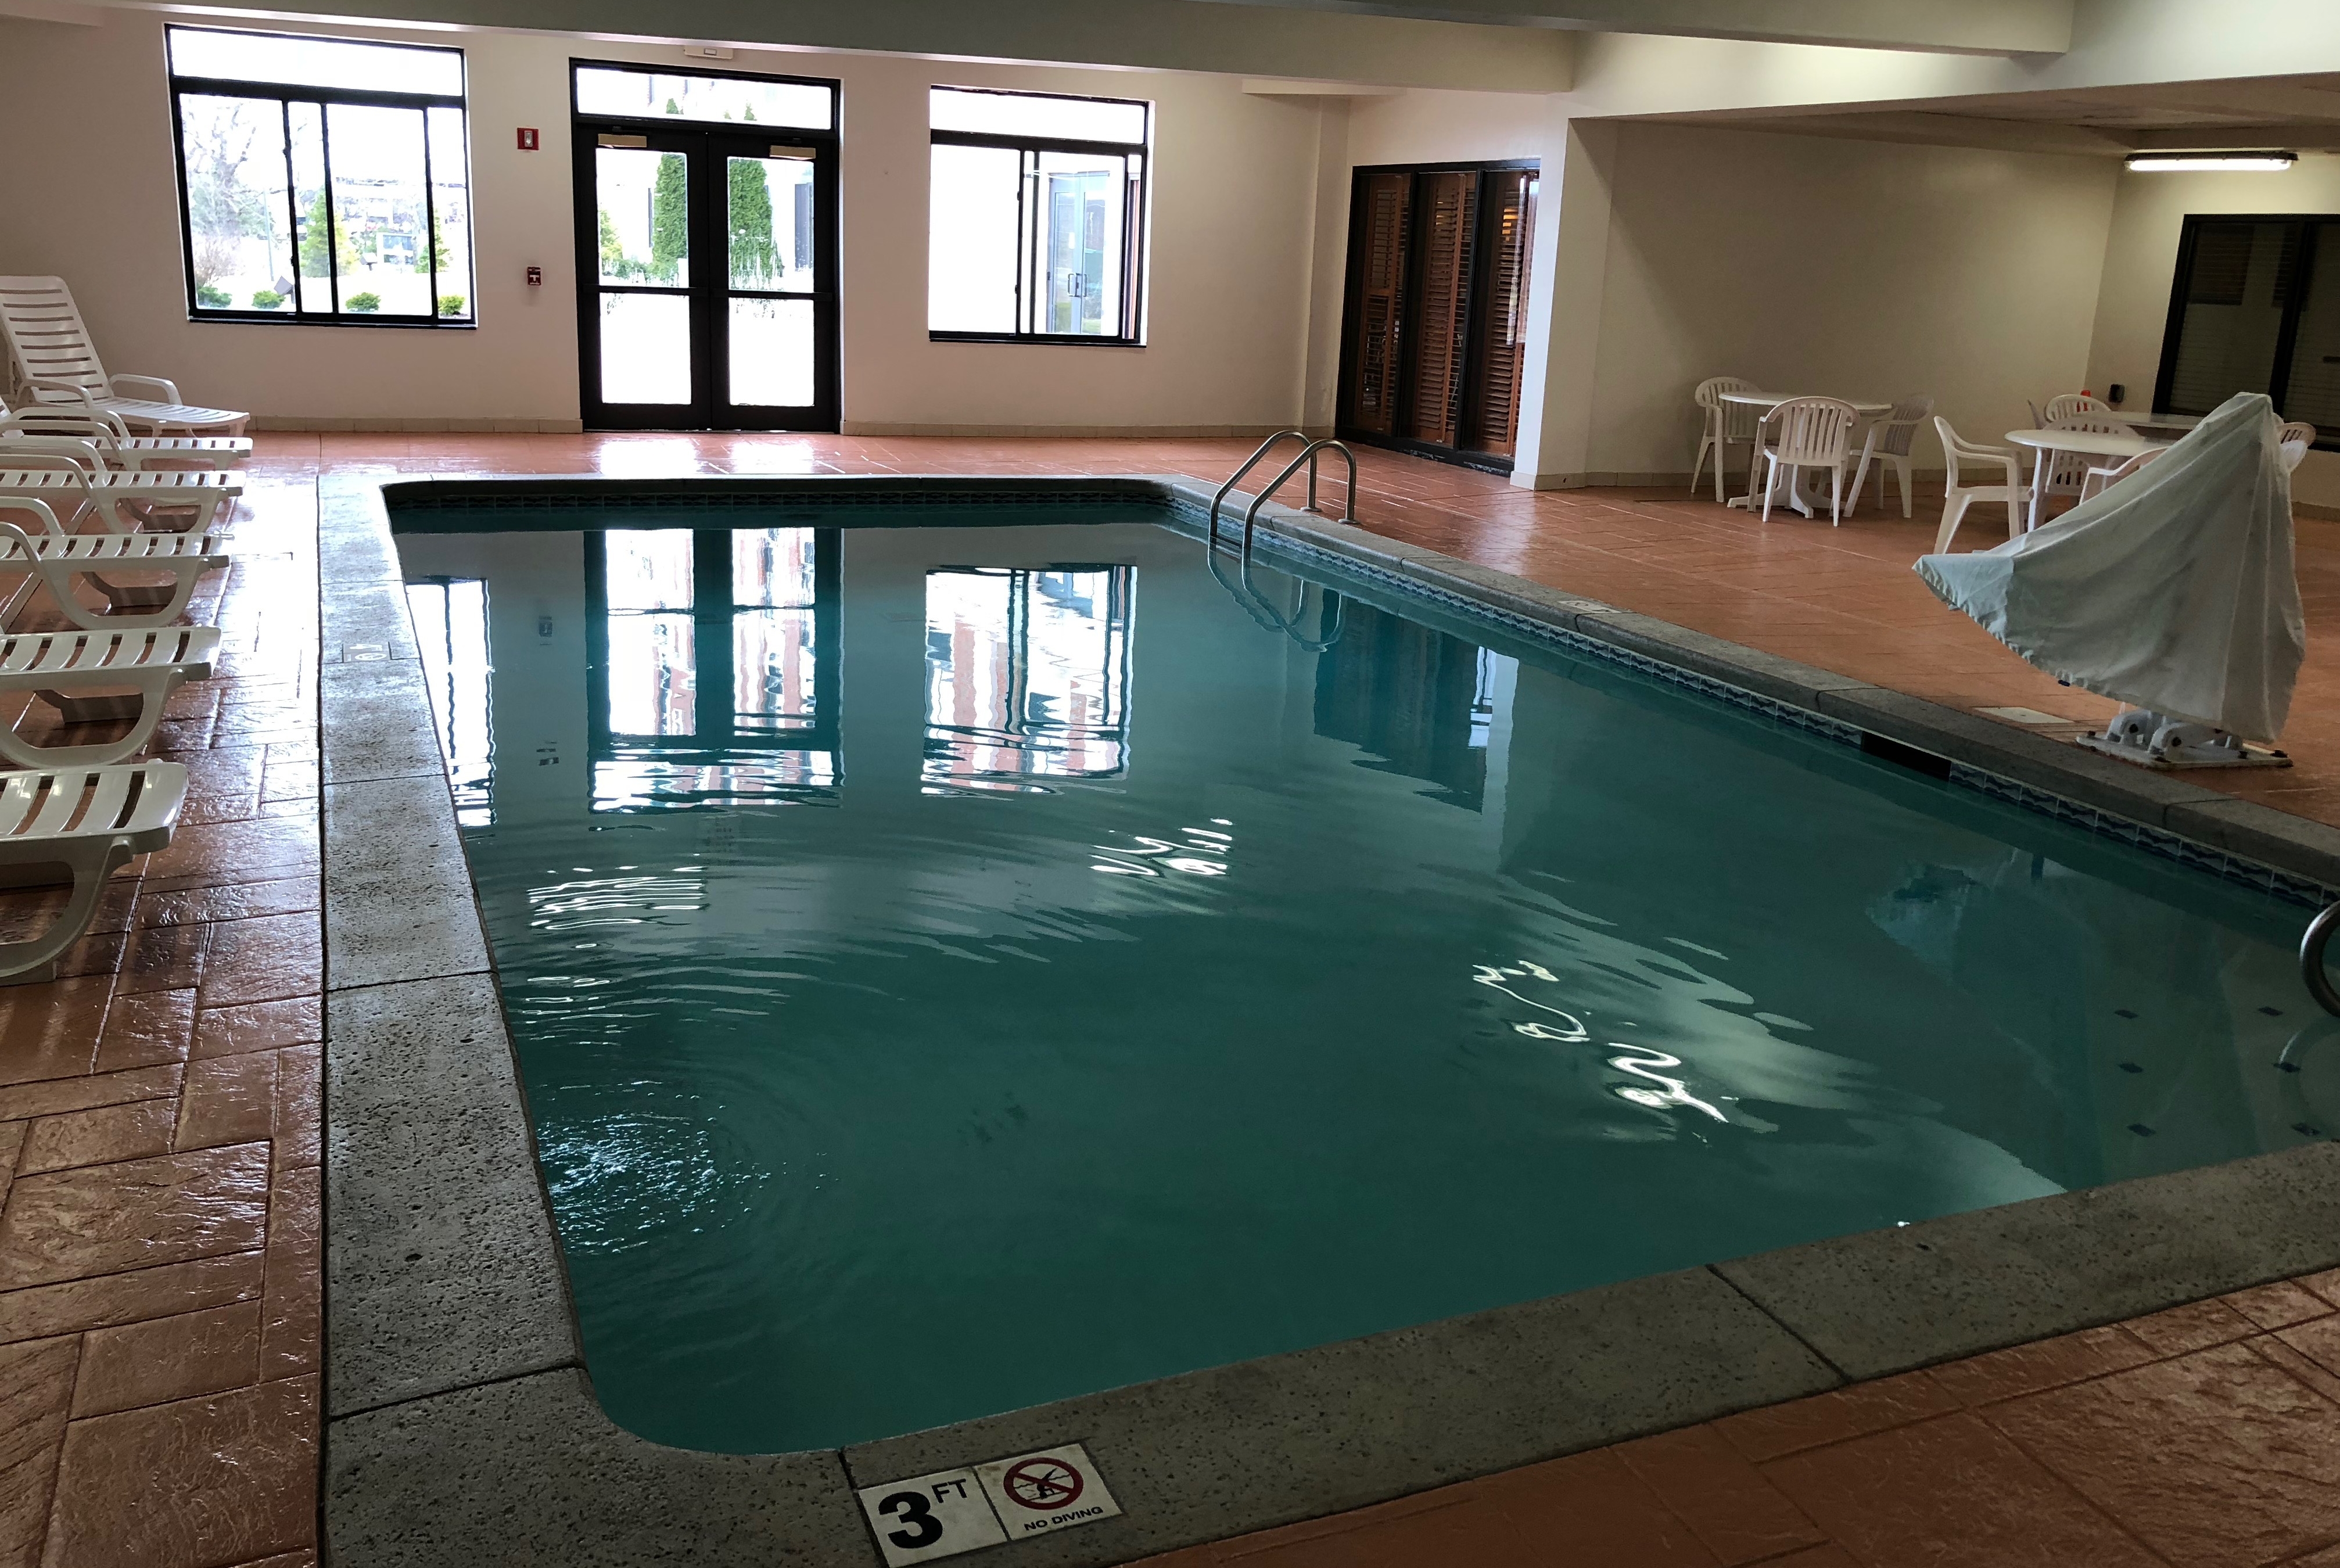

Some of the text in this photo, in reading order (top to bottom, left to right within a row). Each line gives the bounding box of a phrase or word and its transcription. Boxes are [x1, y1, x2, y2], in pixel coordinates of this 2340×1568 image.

[878, 1479, 967, 1549] 3 FT
[1024, 1506, 1104, 1531] NO DIVING
